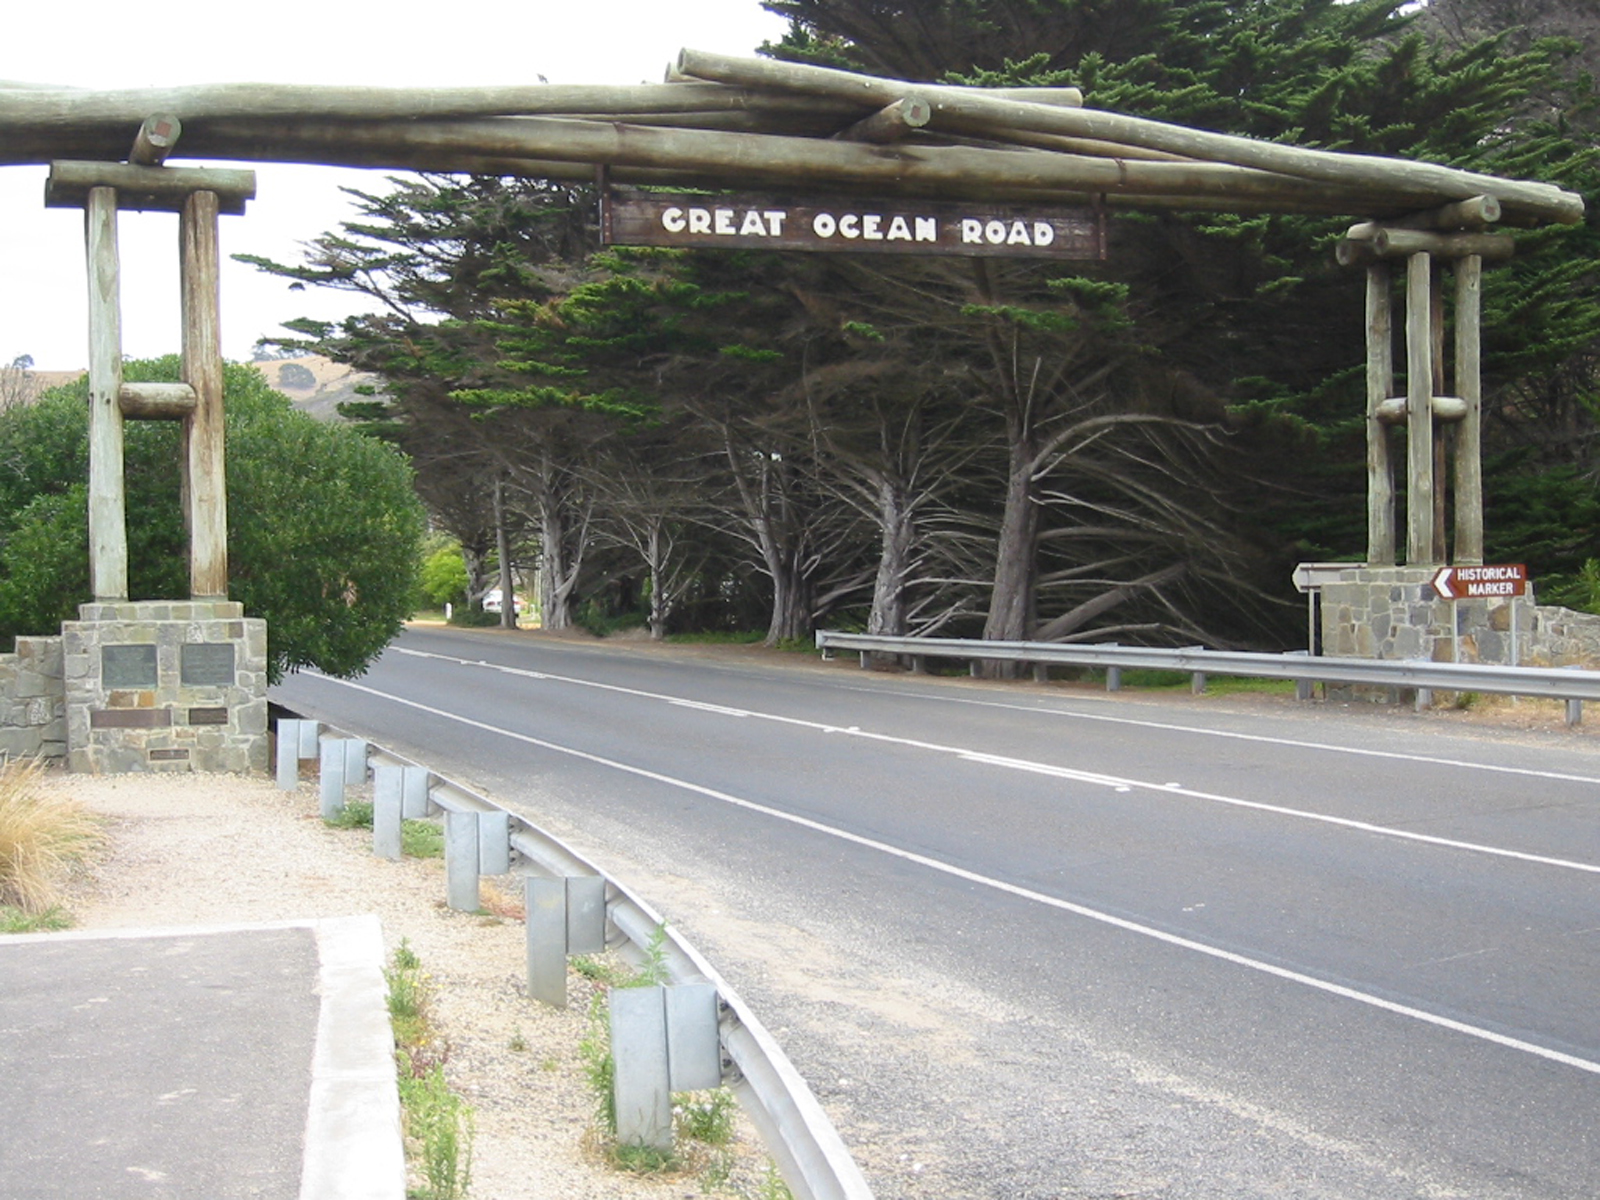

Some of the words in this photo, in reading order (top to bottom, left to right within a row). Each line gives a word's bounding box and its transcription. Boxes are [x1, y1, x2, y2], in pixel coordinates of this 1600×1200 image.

[661, 207, 788, 237] GREAT
[812, 212, 938, 242] OCEAN
[961, 218, 1055, 247] ROAD
[1457, 567, 1521, 581] HISTORICAL
[1468, 582, 1514, 596] MARKER
